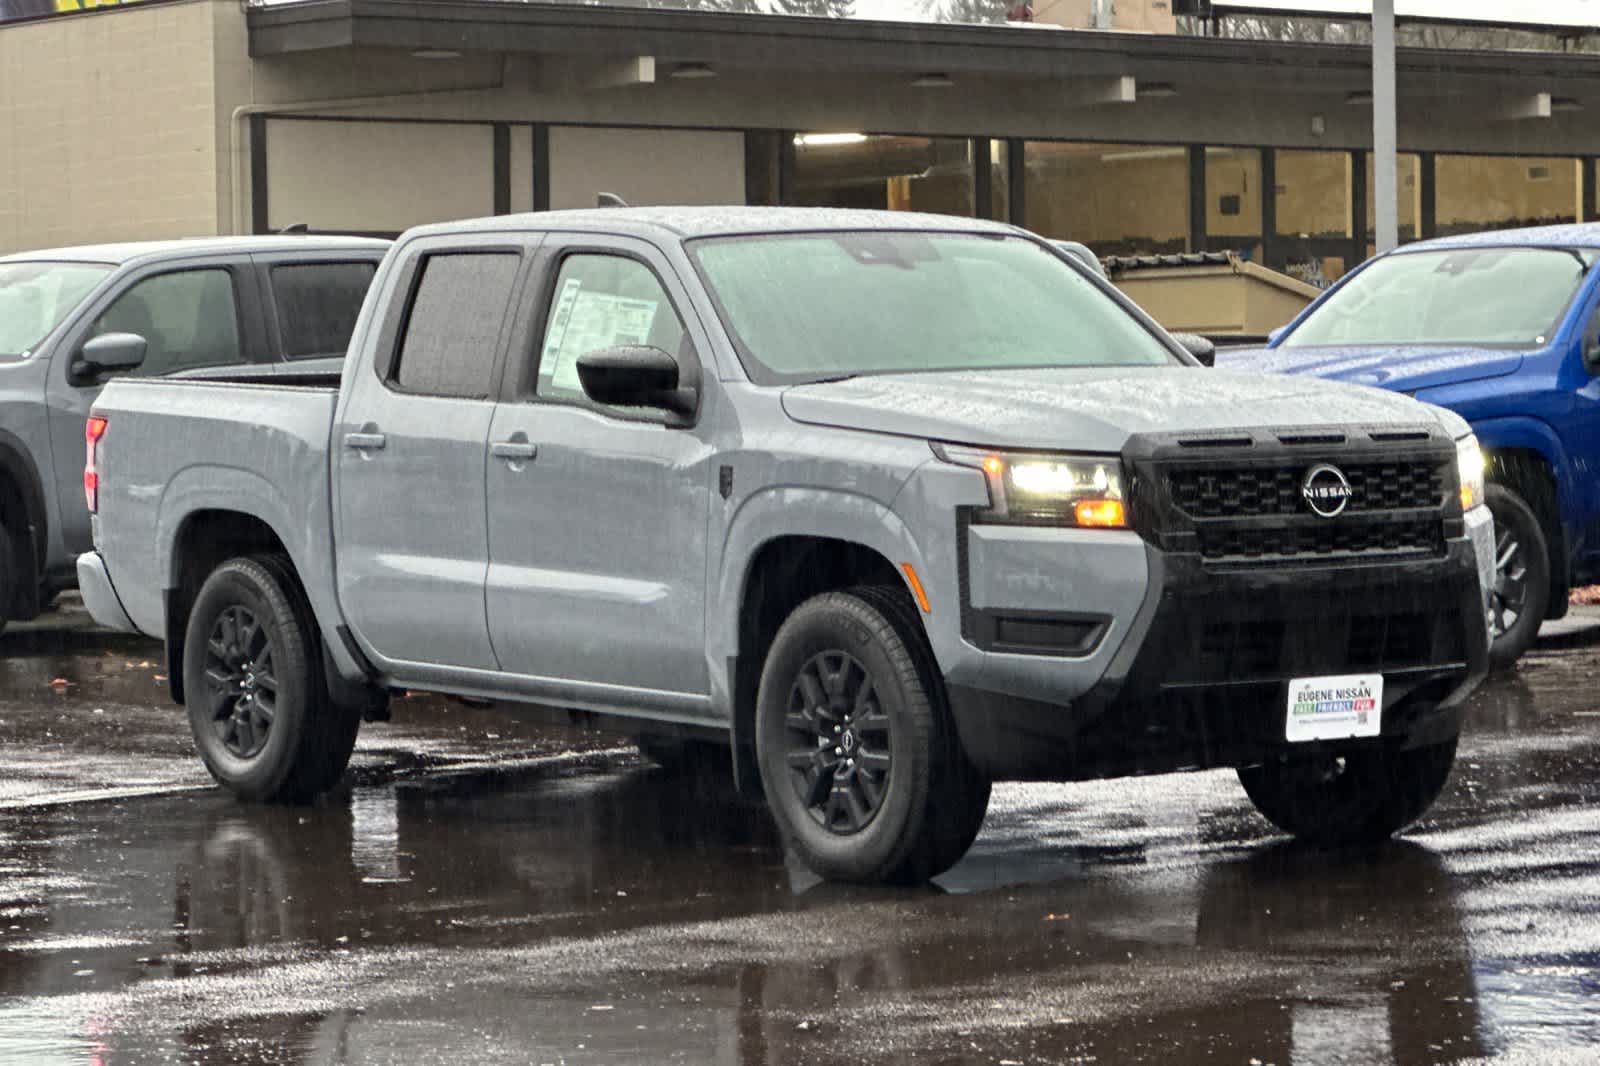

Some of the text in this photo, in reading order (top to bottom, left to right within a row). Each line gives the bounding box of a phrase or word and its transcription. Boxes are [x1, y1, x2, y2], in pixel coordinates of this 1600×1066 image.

[1303, 487, 1352, 498] NISSAN
[1297, 687, 1371, 702] EUGENE NISSAN
